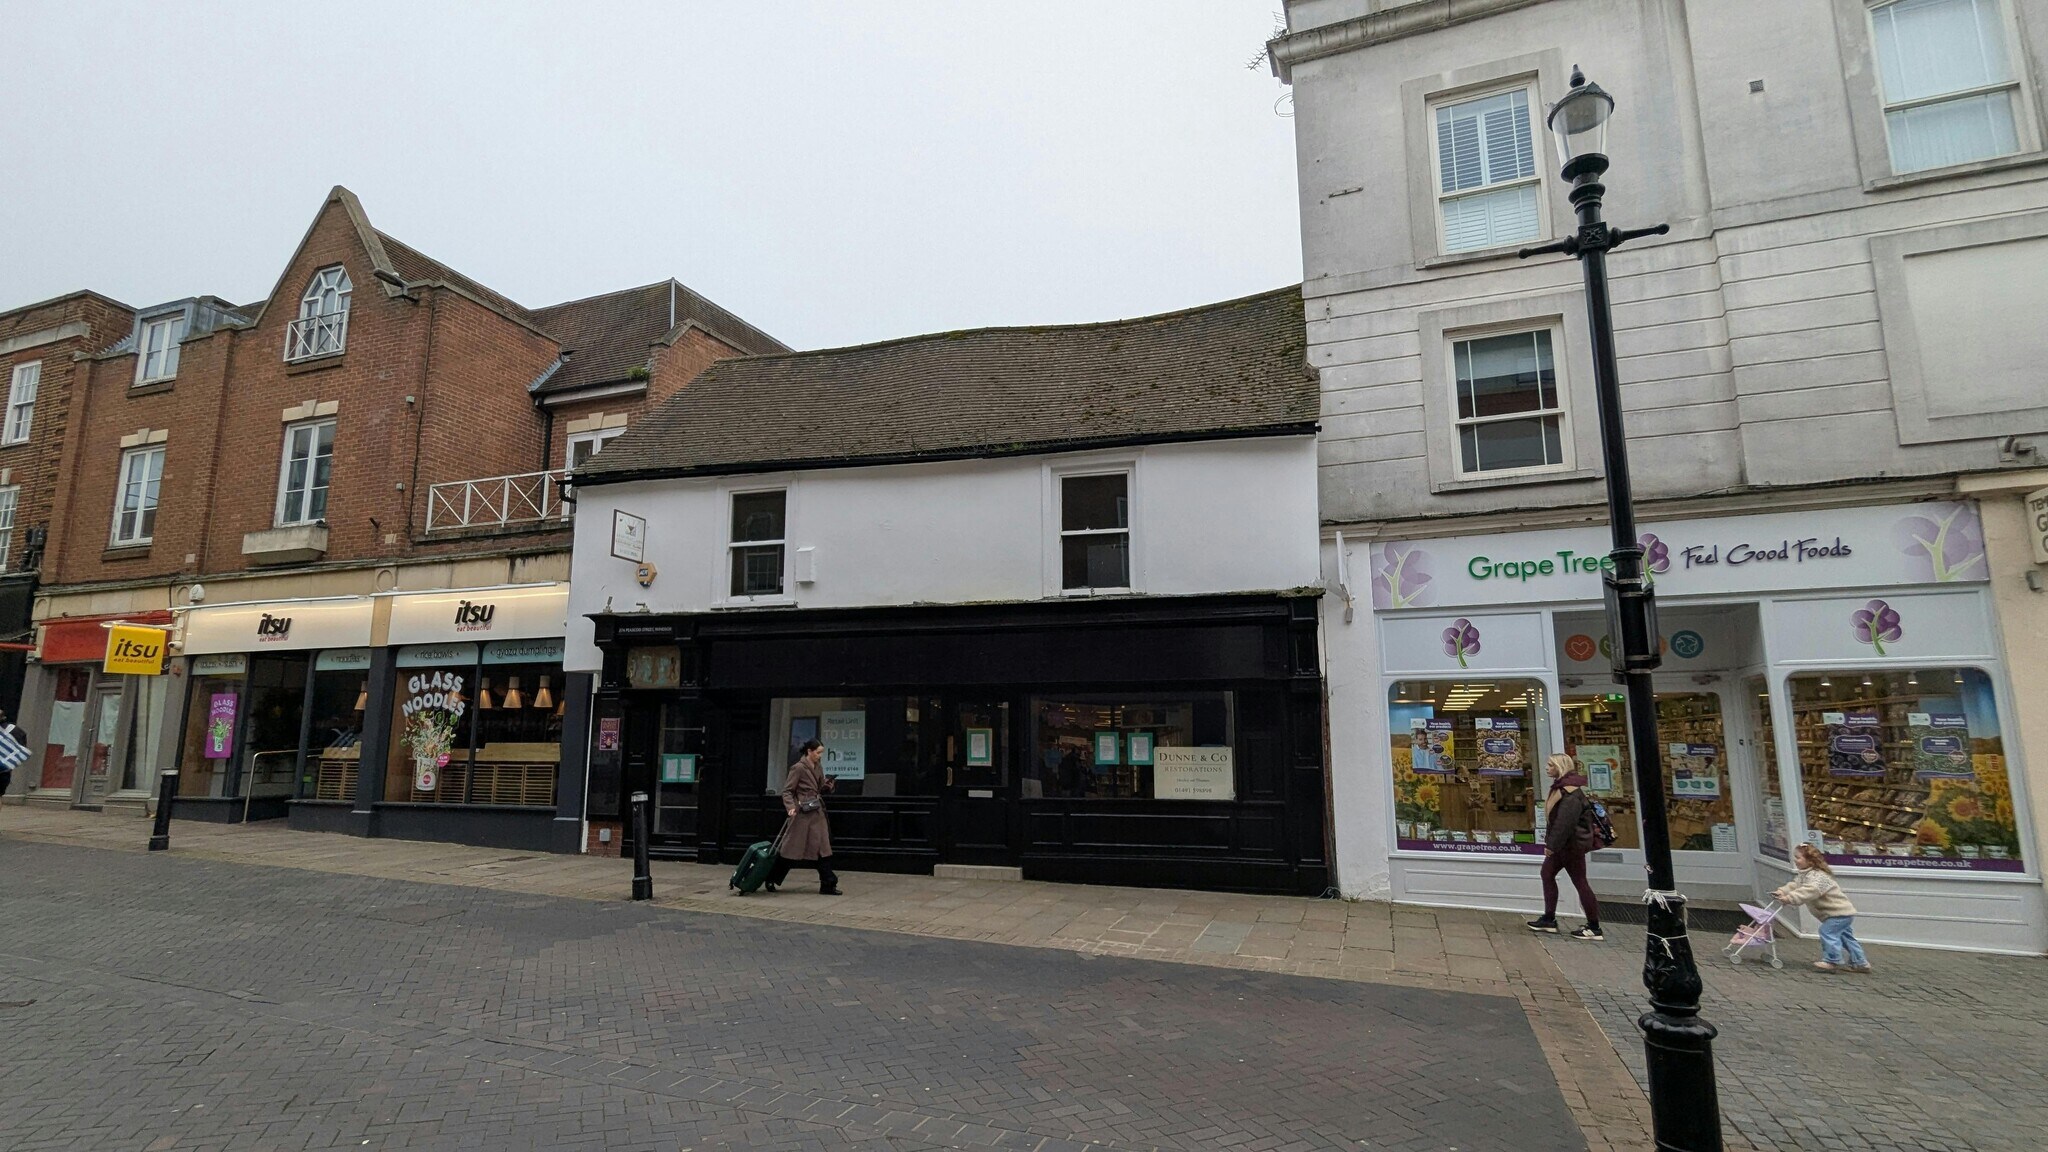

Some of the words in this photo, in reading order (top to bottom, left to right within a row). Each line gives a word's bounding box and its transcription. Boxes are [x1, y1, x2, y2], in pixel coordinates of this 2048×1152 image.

[1679, 544, 1719, 569] Feel
[1726, 540, 1789, 566] Good
[1791, 536, 1853, 563] Foods
[1468, 555, 1554, 582] Grape
[1556, 550, 1614, 574] Tree
[454, 600, 495, 625] itsu
[257, 613, 292, 635] itsu
[467, 623, 492, 632] beautiful
[114, 638, 159, 658] itsu
[518, 646, 557, 658] dumplings
[408, 670, 465, 694] GLASS
[213, 699, 234, 708] GLASS
[401, 692, 466, 717] NOODLES
[211, 706, 235, 716] NOODLES
[823, 729, 839, 740] TO
[841, 729, 863, 740] LET
[1200, 754, 1207, 762] &
[1433, 842, 1522, 852] www.grapetree.co.uk
[1853, 855, 1973, 869] www.grapetree.co.uk
